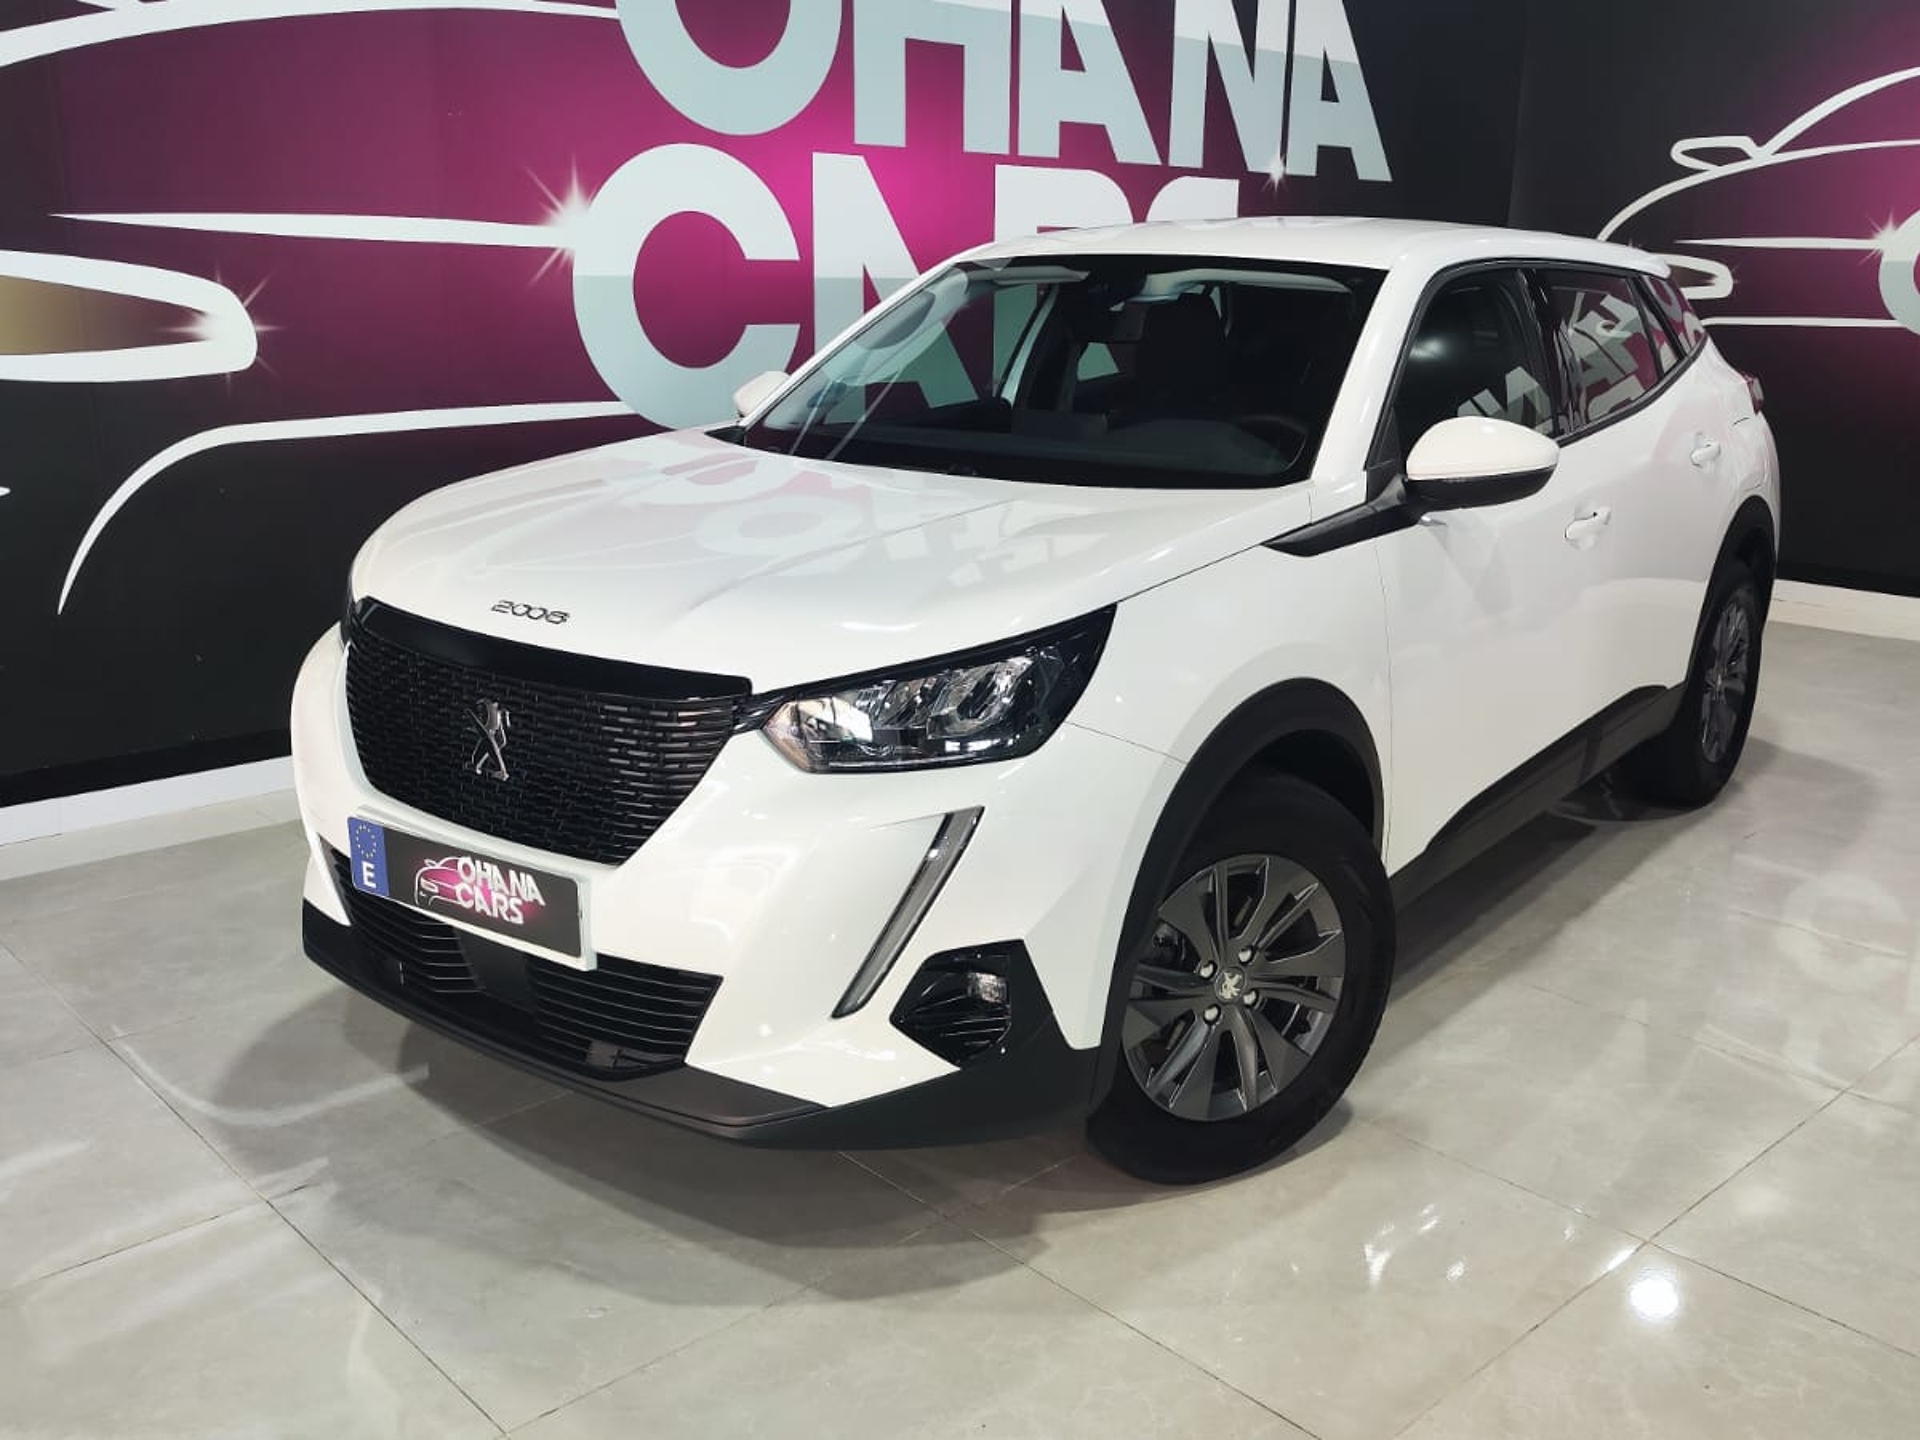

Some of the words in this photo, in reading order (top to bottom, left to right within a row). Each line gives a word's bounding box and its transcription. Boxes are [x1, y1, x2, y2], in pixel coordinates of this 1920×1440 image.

[615, 0, 1393, 182] OHANA
[573, 142, 1239, 430] CA
[490, 600, 569, 625] 2008
[362, 862, 377, 889] E
[458, 856, 546, 906] OHANA
[455, 883, 525, 925] CARS
